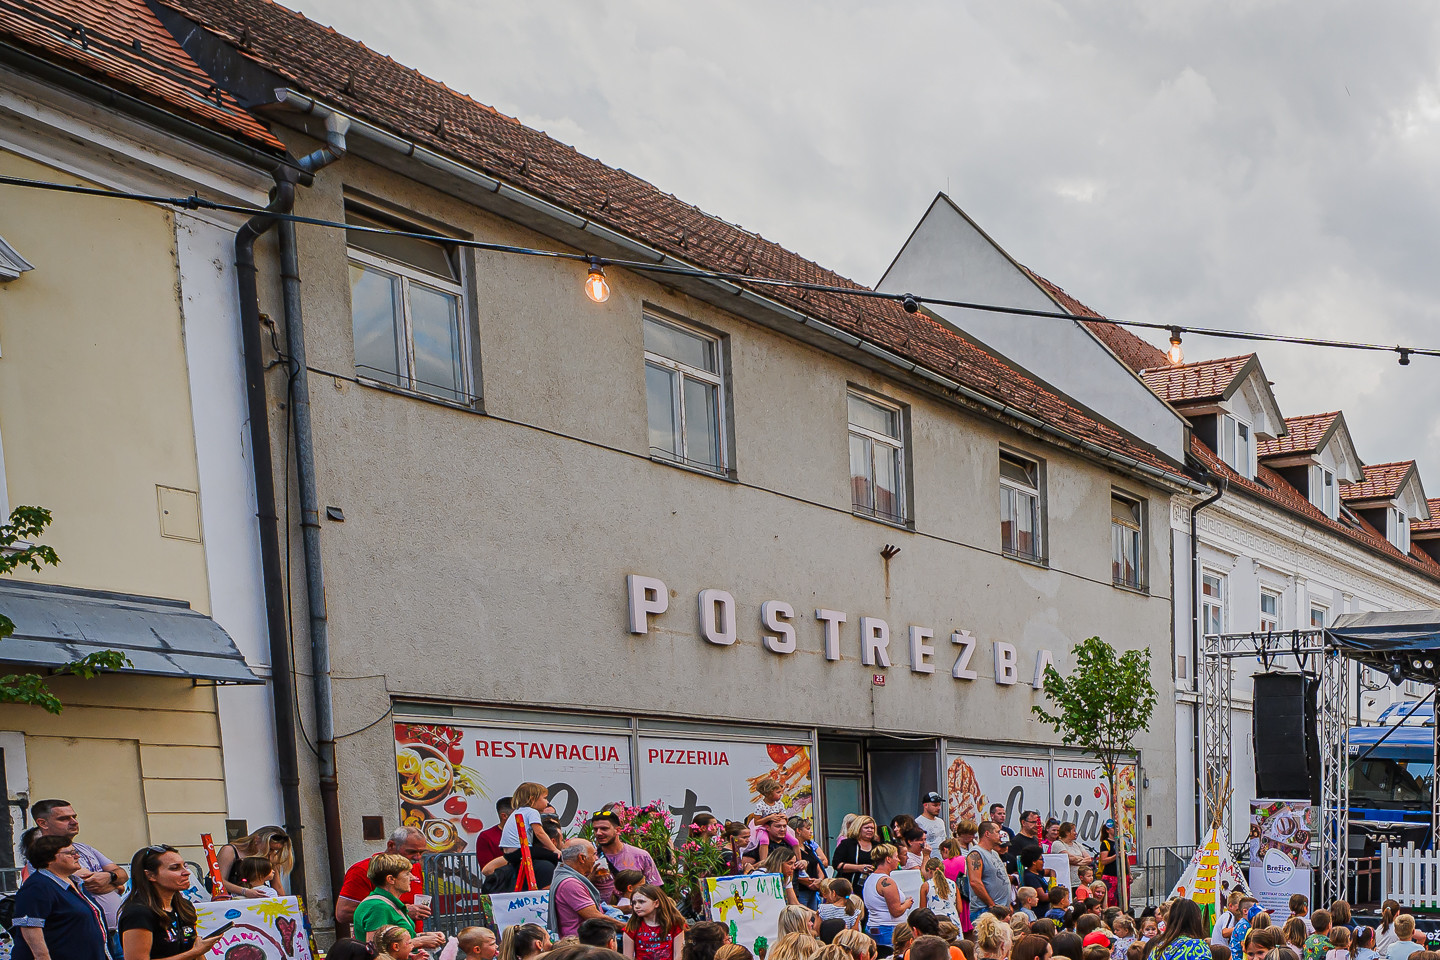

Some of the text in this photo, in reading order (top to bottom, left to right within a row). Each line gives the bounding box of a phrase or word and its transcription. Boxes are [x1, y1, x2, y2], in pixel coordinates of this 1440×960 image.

[627, 574, 1056, 689] POSTREŽBA
[475, 740, 620, 762] RESTAVRACIJA
[648, 748, 729, 766] PIZZERIJA
[1000, 765, 1045, 778] GOSTILNA
[1057, 767, 1096, 780] CATERING
[1366, 833, 1401, 842] MAN
[1266, 864, 1292, 872] Brežice
[508, 892, 549, 911] ANDRA
